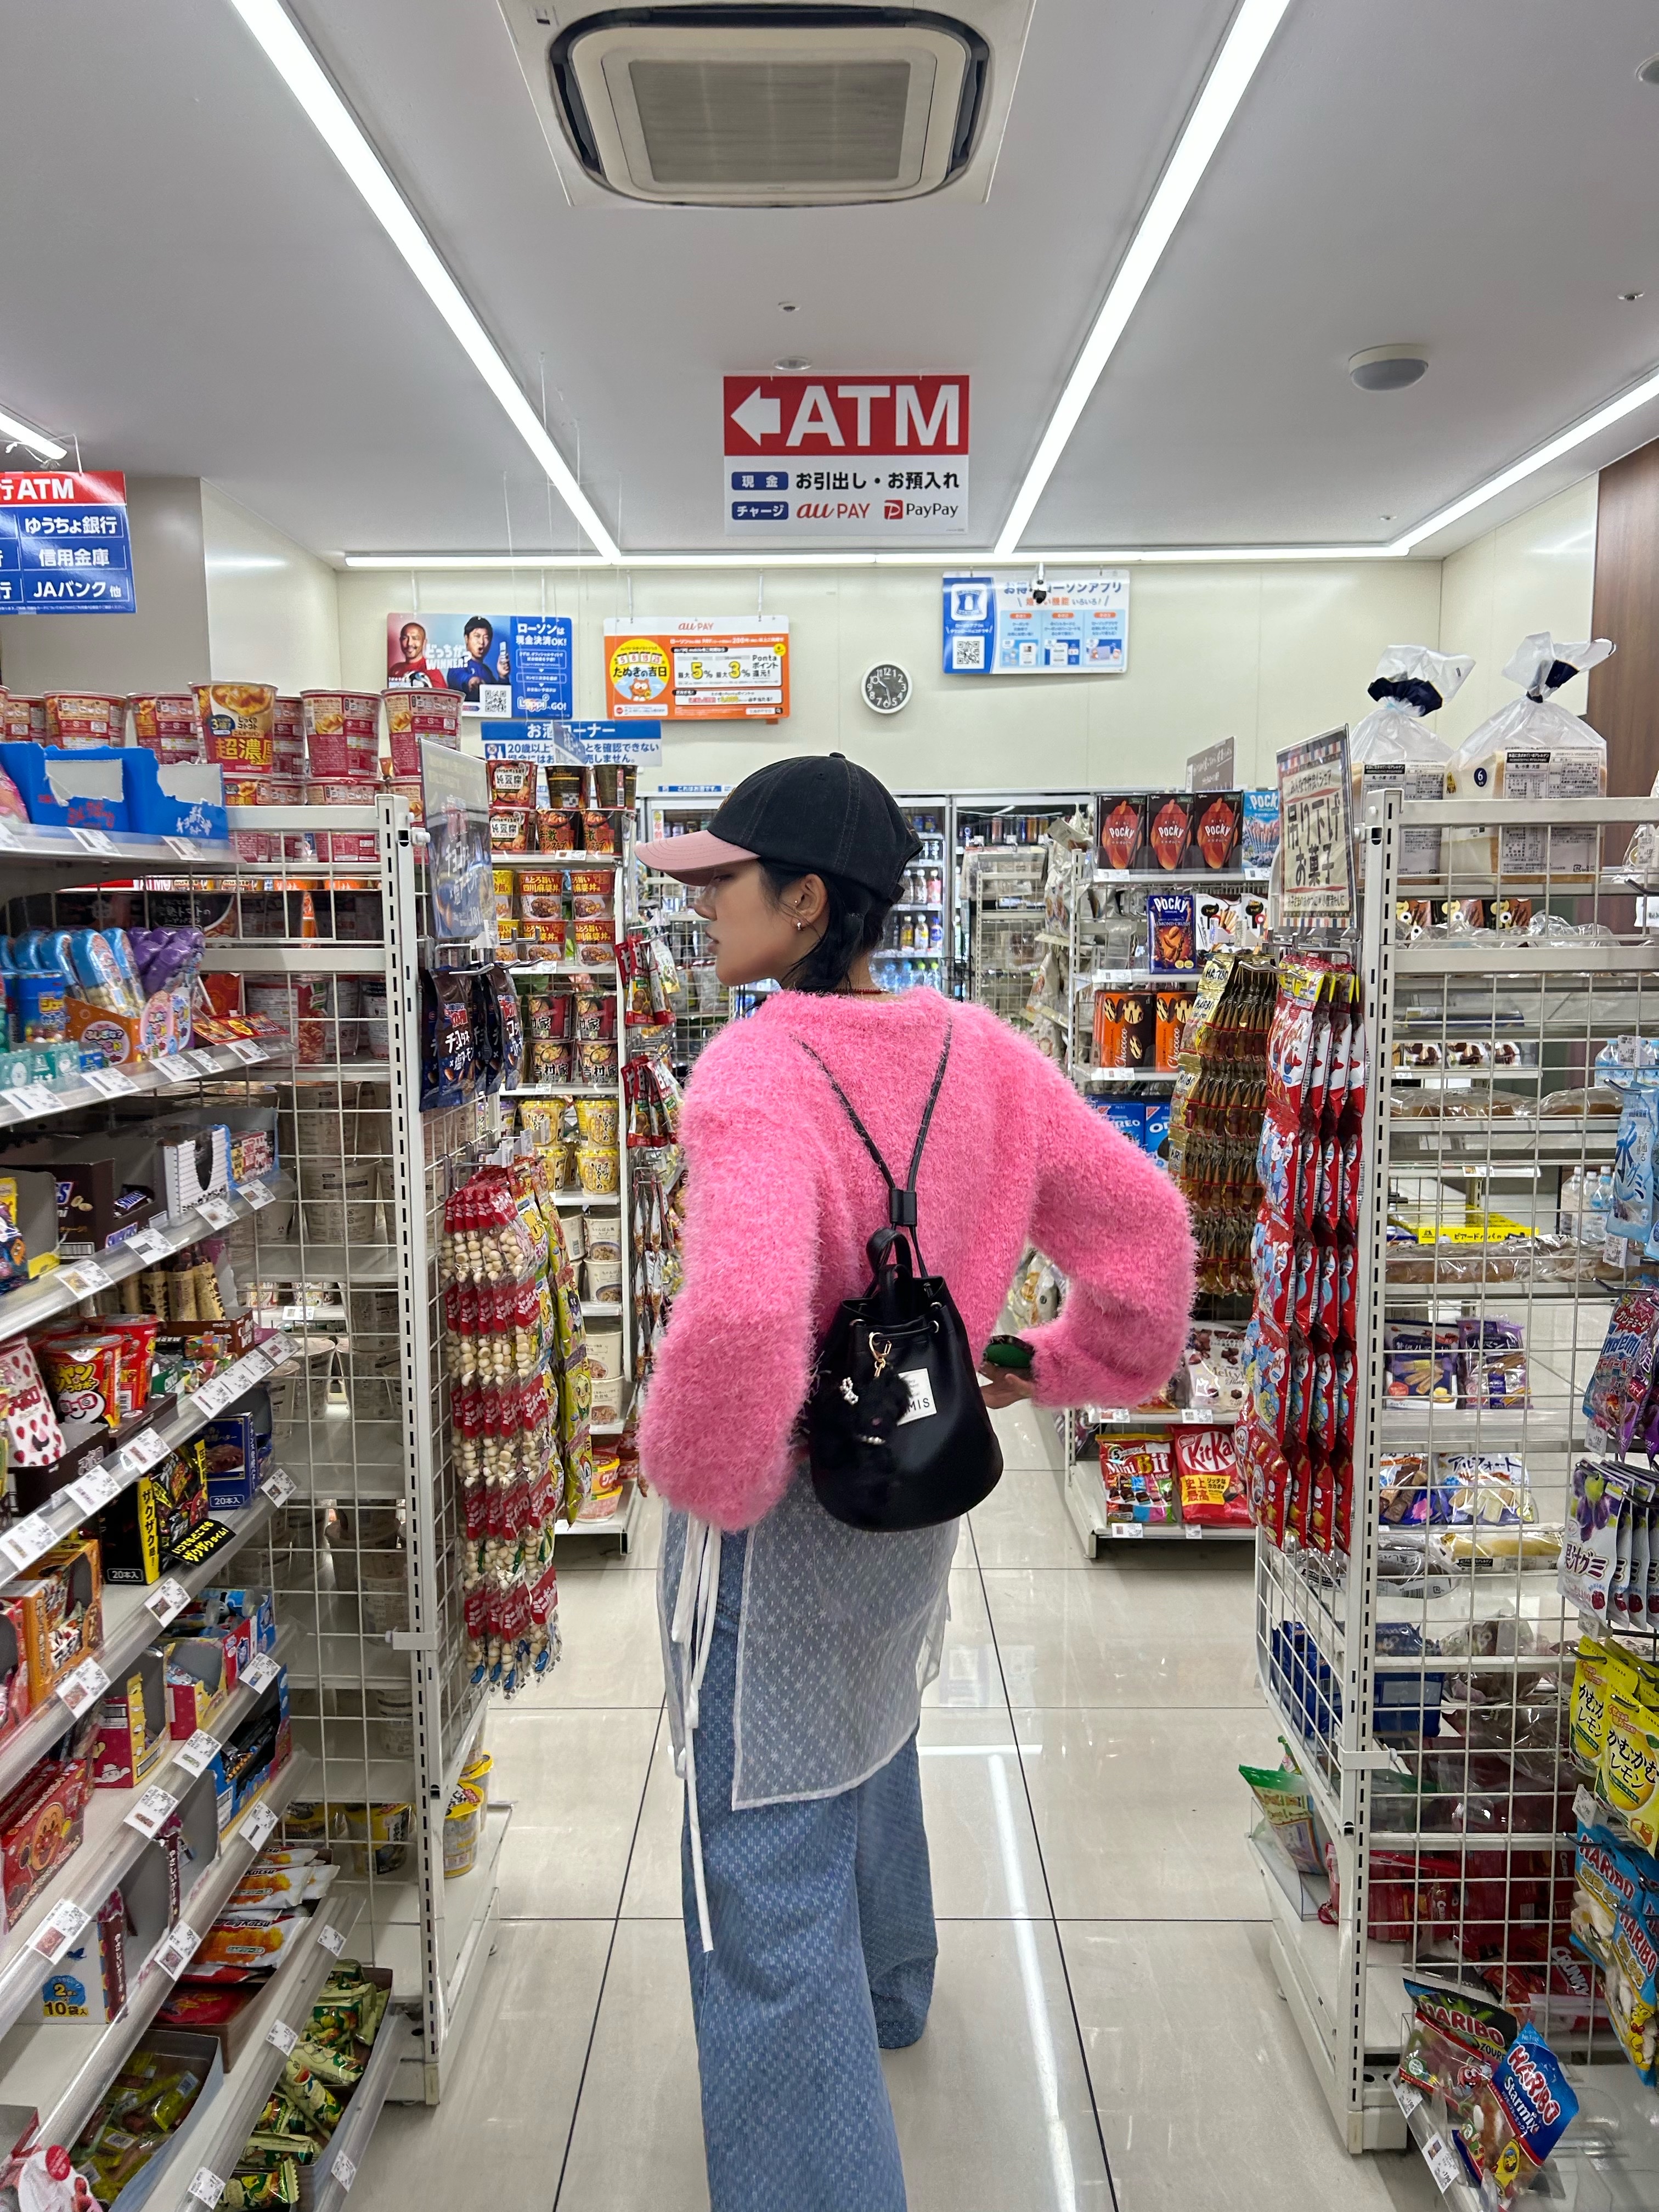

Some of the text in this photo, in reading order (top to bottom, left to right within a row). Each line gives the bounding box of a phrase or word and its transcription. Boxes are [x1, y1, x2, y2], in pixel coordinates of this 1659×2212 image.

[786, 385, 959, 446] ATM
[796, 472, 959, 490] お引出し・お預入れ
[737, 506, 784, 517] チャージ
[837, 503, 870, 518] PAY
[907, 503, 958, 516] PayPay
[25, 516, 117, 534] ゆうちょ銀行
[40, 548, 110, 567] 信用金庫
[33, 579, 106, 597] JAバンク
[110, 585, 121, 597] 他
[518, 623, 565, 635] ローソンは
[613, 667, 667, 678] たぬきの吉日
[1477, 770, 1483, 782] 6
[1295, 843, 1334, 887] お菓子
[1154, 896, 1188, 913] Pocky
[534, 1064, 568, 1077] 吉村家
[1187, 1431, 1233, 1471] KitKa
[1106, 1453, 1170, 1475] Mini Bit
[1186, 1477, 1206, 1490] 史上
[215, 1497, 241, 1506] 20本入
[1188, 1490, 1209, 1502] 最高
[171, 1520, 215, 1554] いつでもどこでも
[182, 1527, 230, 1561] ザクザクタイム!
[1566, 1542, 1607, 1579] 果汁グミ
[111, 1570, 139, 1580] 20本入
[1578, 1706, 1602, 1737] レモン
[1607, 1729, 1659, 1785] かむかむ
[1611, 1752, 1645, 1789] レモン
[1419, 1998, 1505, 2048] HARIBO
[1506, 2045, 1562, 2126] HARIBO
[1503, 2075, 1538, 2134] Starmix
